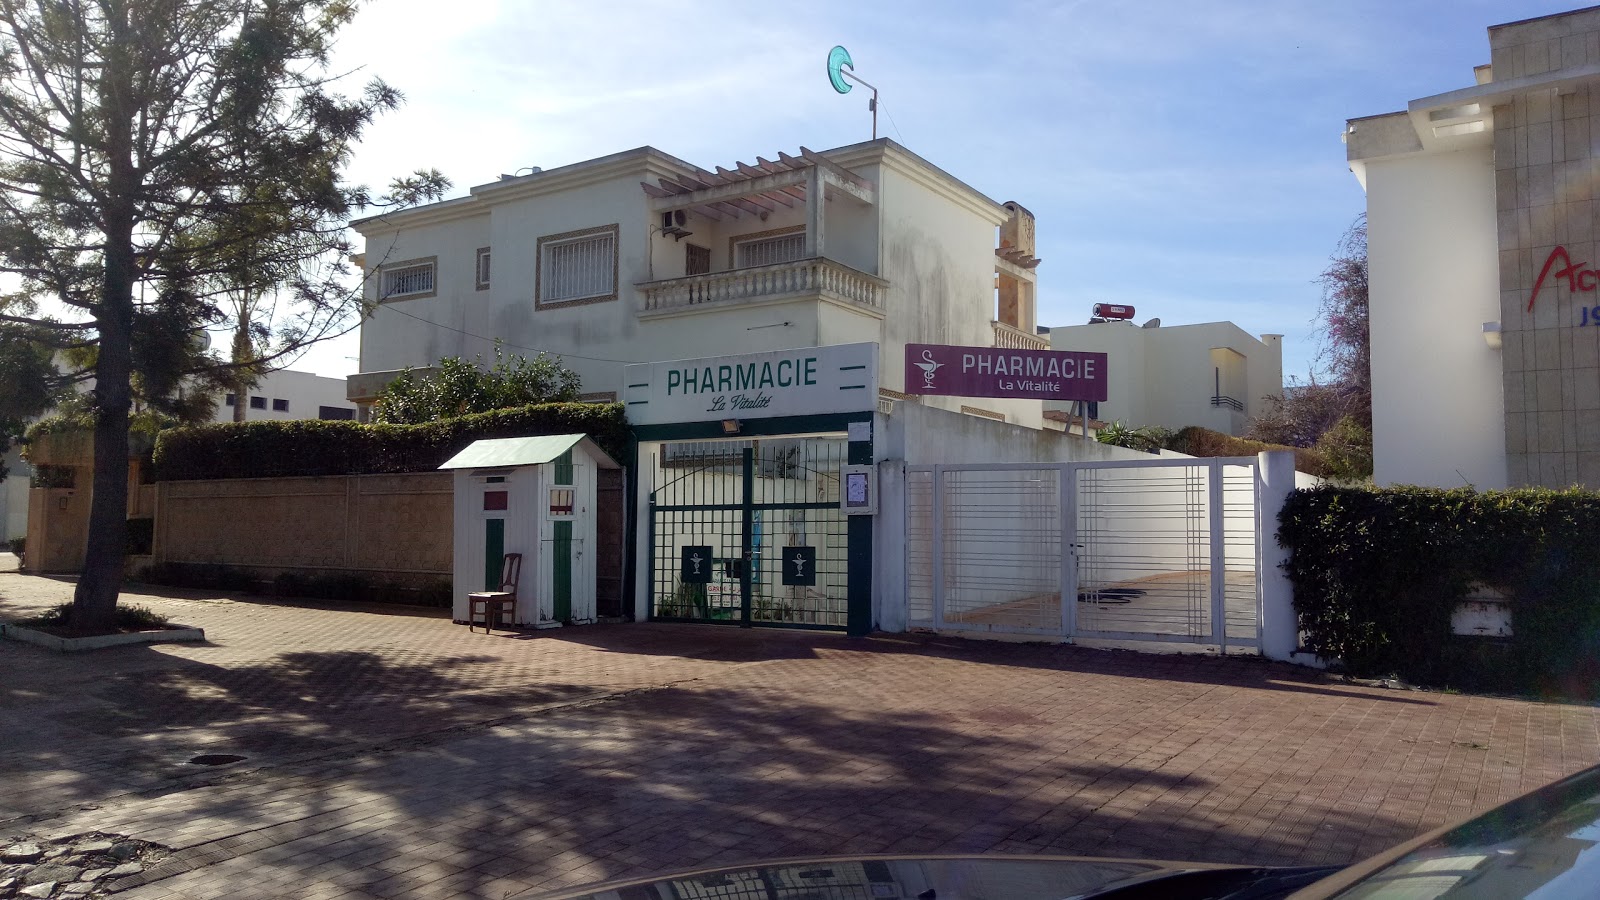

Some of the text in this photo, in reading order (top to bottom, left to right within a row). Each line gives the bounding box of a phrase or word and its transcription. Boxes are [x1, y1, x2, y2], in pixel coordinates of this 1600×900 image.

[668, 357, 817, 395] PHARMACIE
[962, 354, 1095, 379] PHARMACIE
[999, 379, 1060, 392] La Vitalité
[706, 391, 773, 412] La Vitalité
